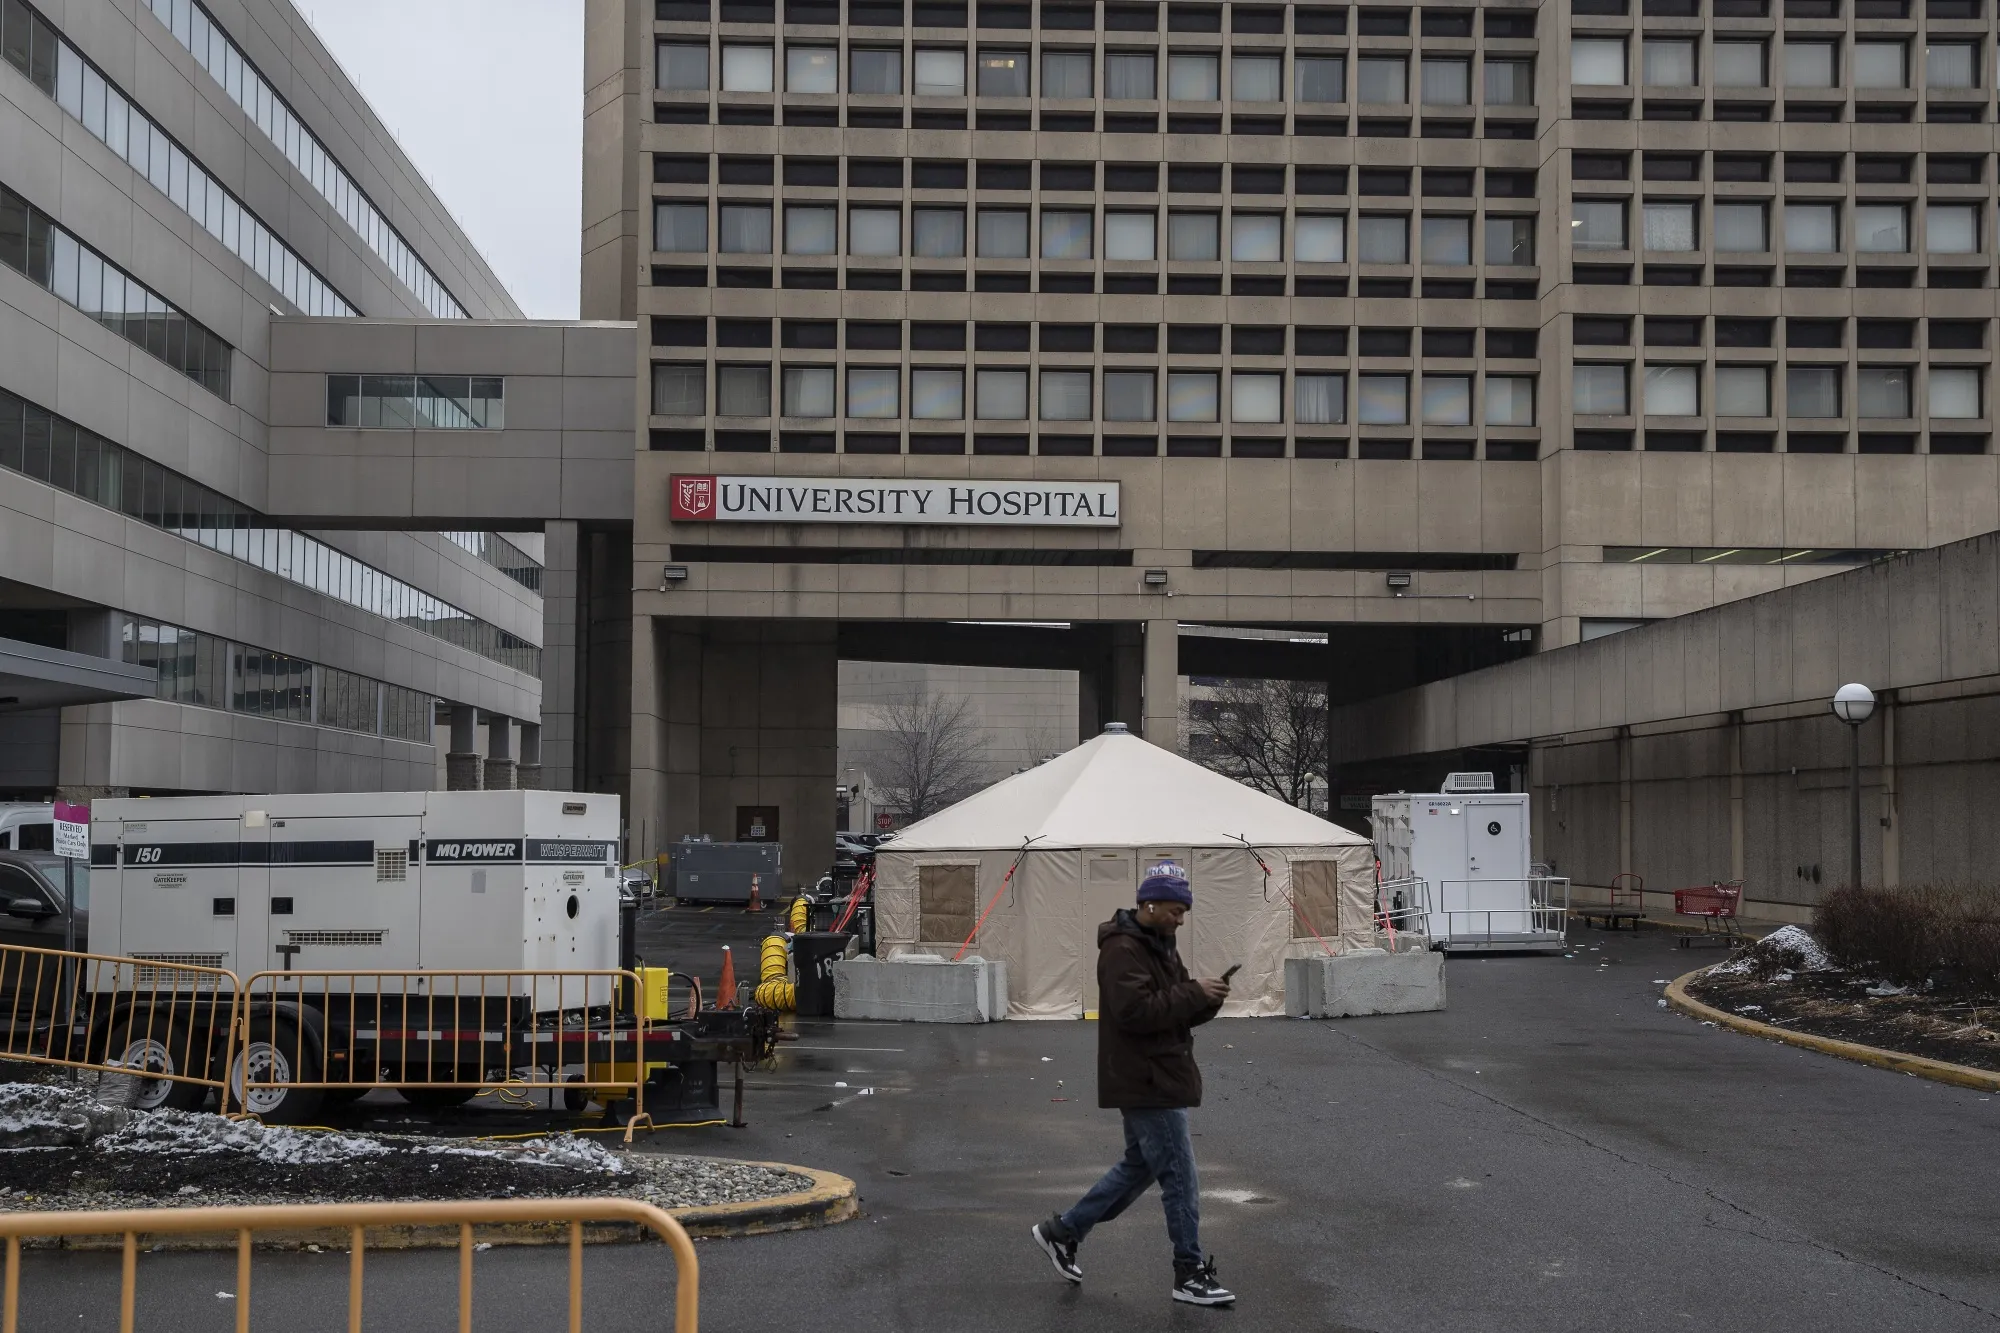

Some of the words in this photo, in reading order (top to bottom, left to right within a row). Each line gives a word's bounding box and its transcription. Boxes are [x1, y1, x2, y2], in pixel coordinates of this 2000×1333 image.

[721, 484, 933, 514] UNIVERSITY
[948, 487, 1118, 518] HOSPITAL
[60, 823, 83, 833] RESERVED
[135, 847, 162, 863] 150
[436, 844, 460, 858] MQ
[462, 843, 516, 857] POWER
[540, 843, 606, 857] WHISPERWATT
